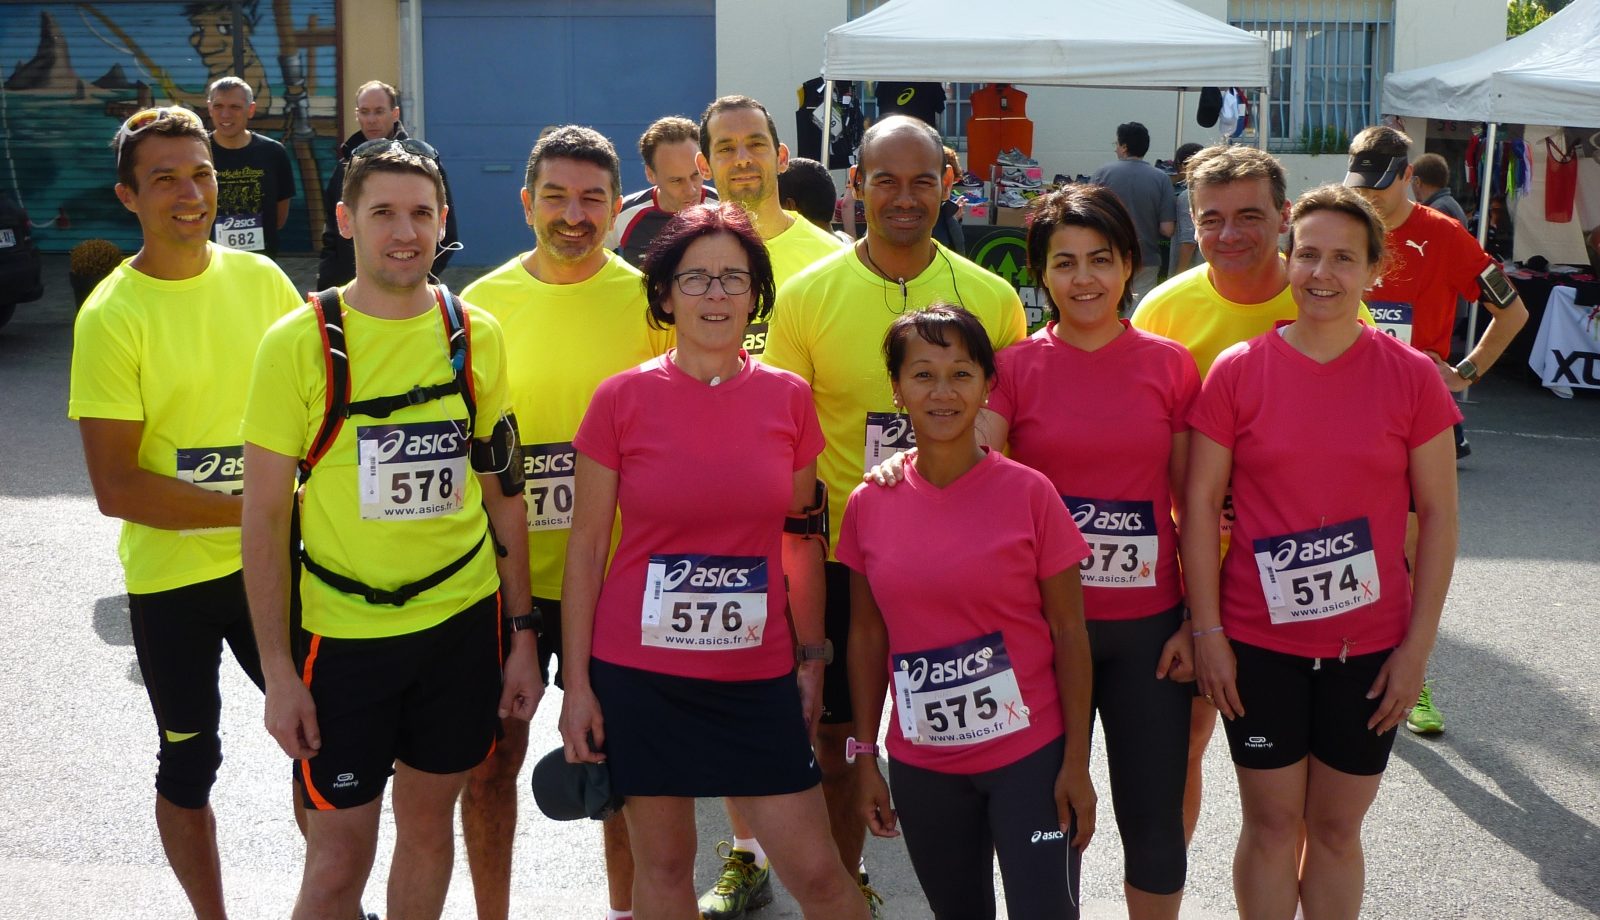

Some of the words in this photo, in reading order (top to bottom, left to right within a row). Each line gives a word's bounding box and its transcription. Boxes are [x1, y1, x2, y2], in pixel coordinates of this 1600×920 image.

[233, 217, 256, 228] asics
[228, 232, 255, 246] 682
[742, 332, 765, 350] as
[405, 432, 458, 456] asics
[221, 457, 244, 476] as
[524, 453, 574, 474] asics
[391, 467, 453, 504] 578
[385, 502, 453, 516] www.asics.fr
[528, 484, 573, 515] 70
[1093, 511, 1142, 531] asics
[1299, 532, 1354, 562] asics
[689, 567, 749, 587] asics
[1292, 563, 1359, 606] 574
[1290, 595, 1361, 617] www.asics.fr
[671, 600, 743, 633] 576
[665, 635, 742, 645] www.asics.fr
[930, 649, 988, 684] asics
[924, 685, 998, 733] 575
[928, 722, 1004, 742] www.asics.fr
[1042, 830, 1064, 841] asics
